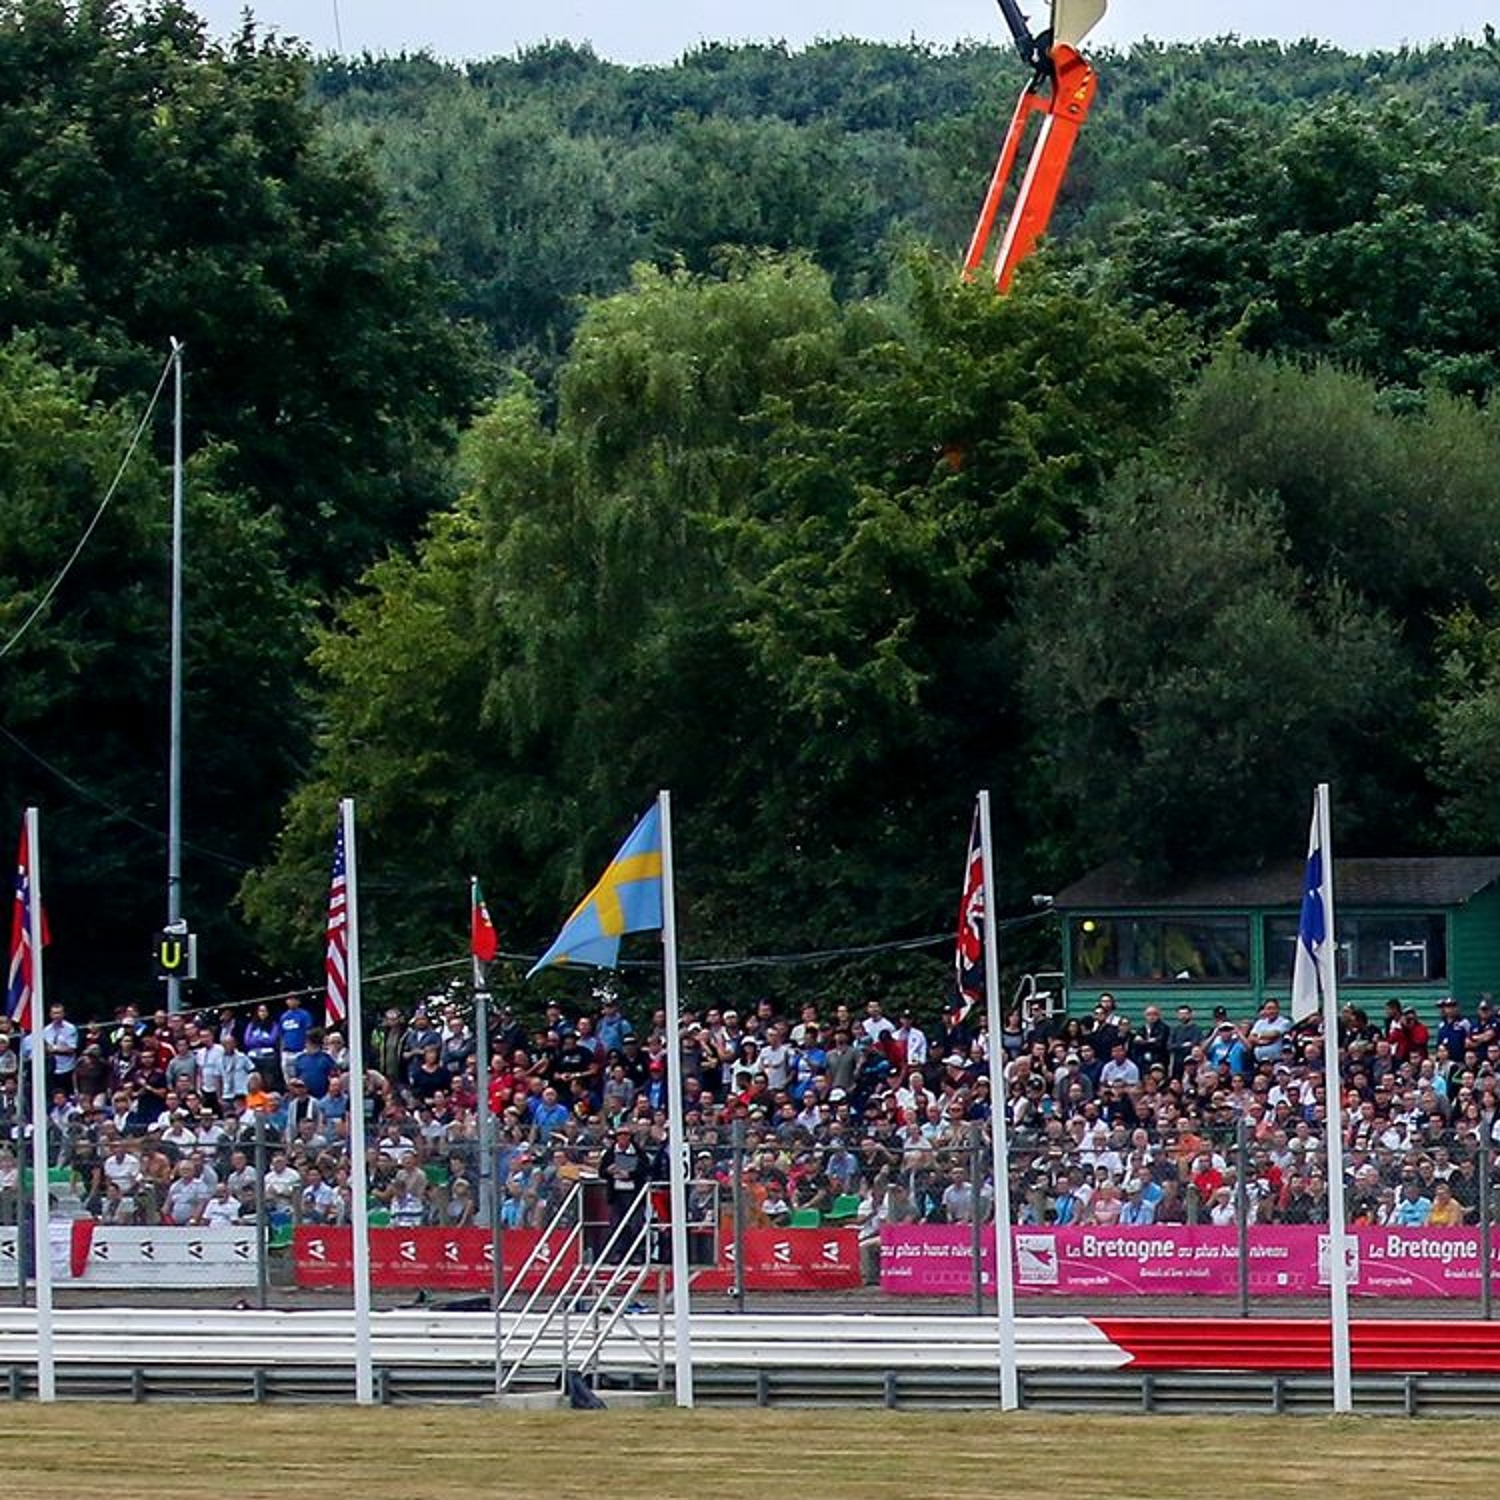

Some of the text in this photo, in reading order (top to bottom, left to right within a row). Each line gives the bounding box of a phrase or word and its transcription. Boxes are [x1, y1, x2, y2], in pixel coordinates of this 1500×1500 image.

[161, 941, 181, 969] U
[1066, 1243, 1081, 1257] La
[1083, 1234, 1175, 1263] Bretagne
[1369, 1244, 1385, 1258] La
[1387, 1235, 1478, 1264] Bretagne
